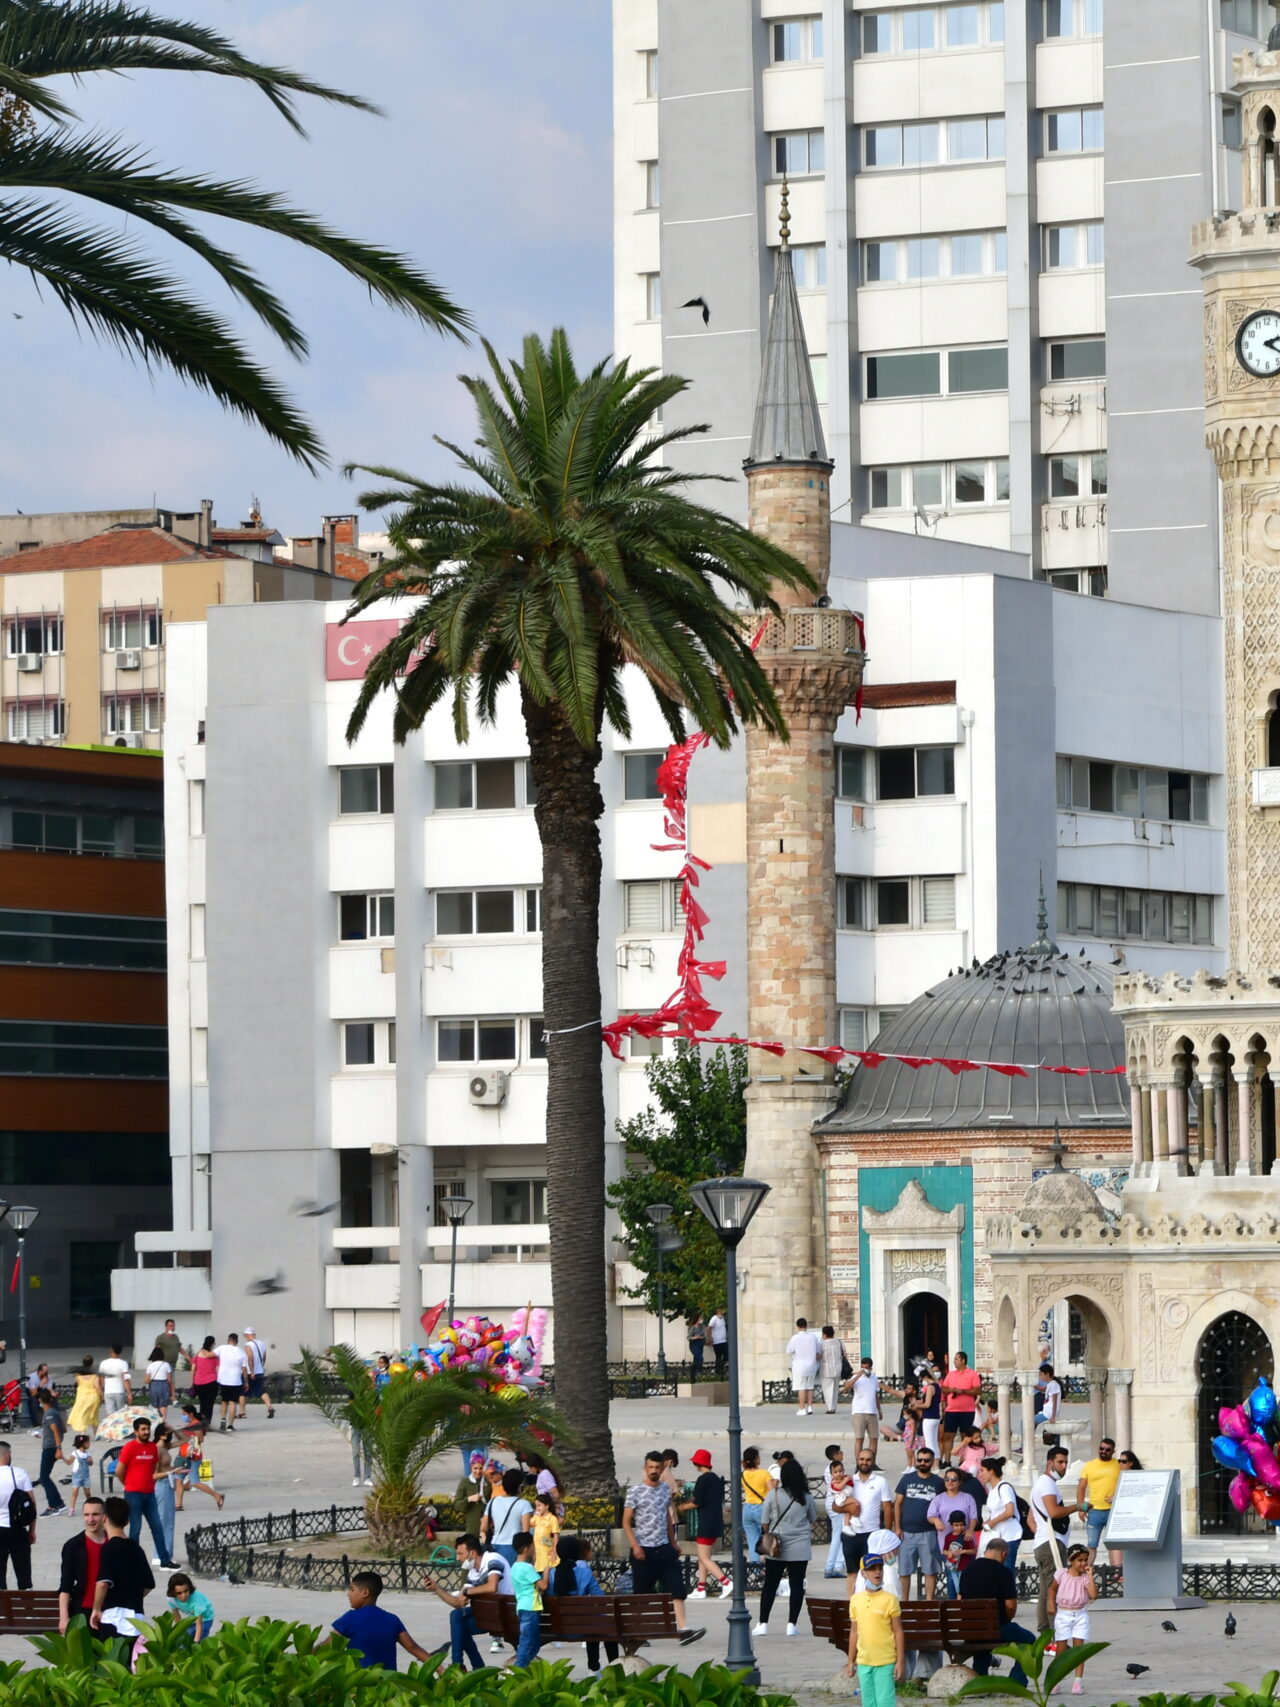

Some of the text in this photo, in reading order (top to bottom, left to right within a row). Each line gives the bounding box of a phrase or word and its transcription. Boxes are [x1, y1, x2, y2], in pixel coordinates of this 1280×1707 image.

[1255, 321, 1261, 329] 11
[1263, 317, 1271, 326] 12
[1247, 330, 1256, 338] 10
[1248, 352, 1253, 360] 8
[1265, 361, 1270, 370] 6
